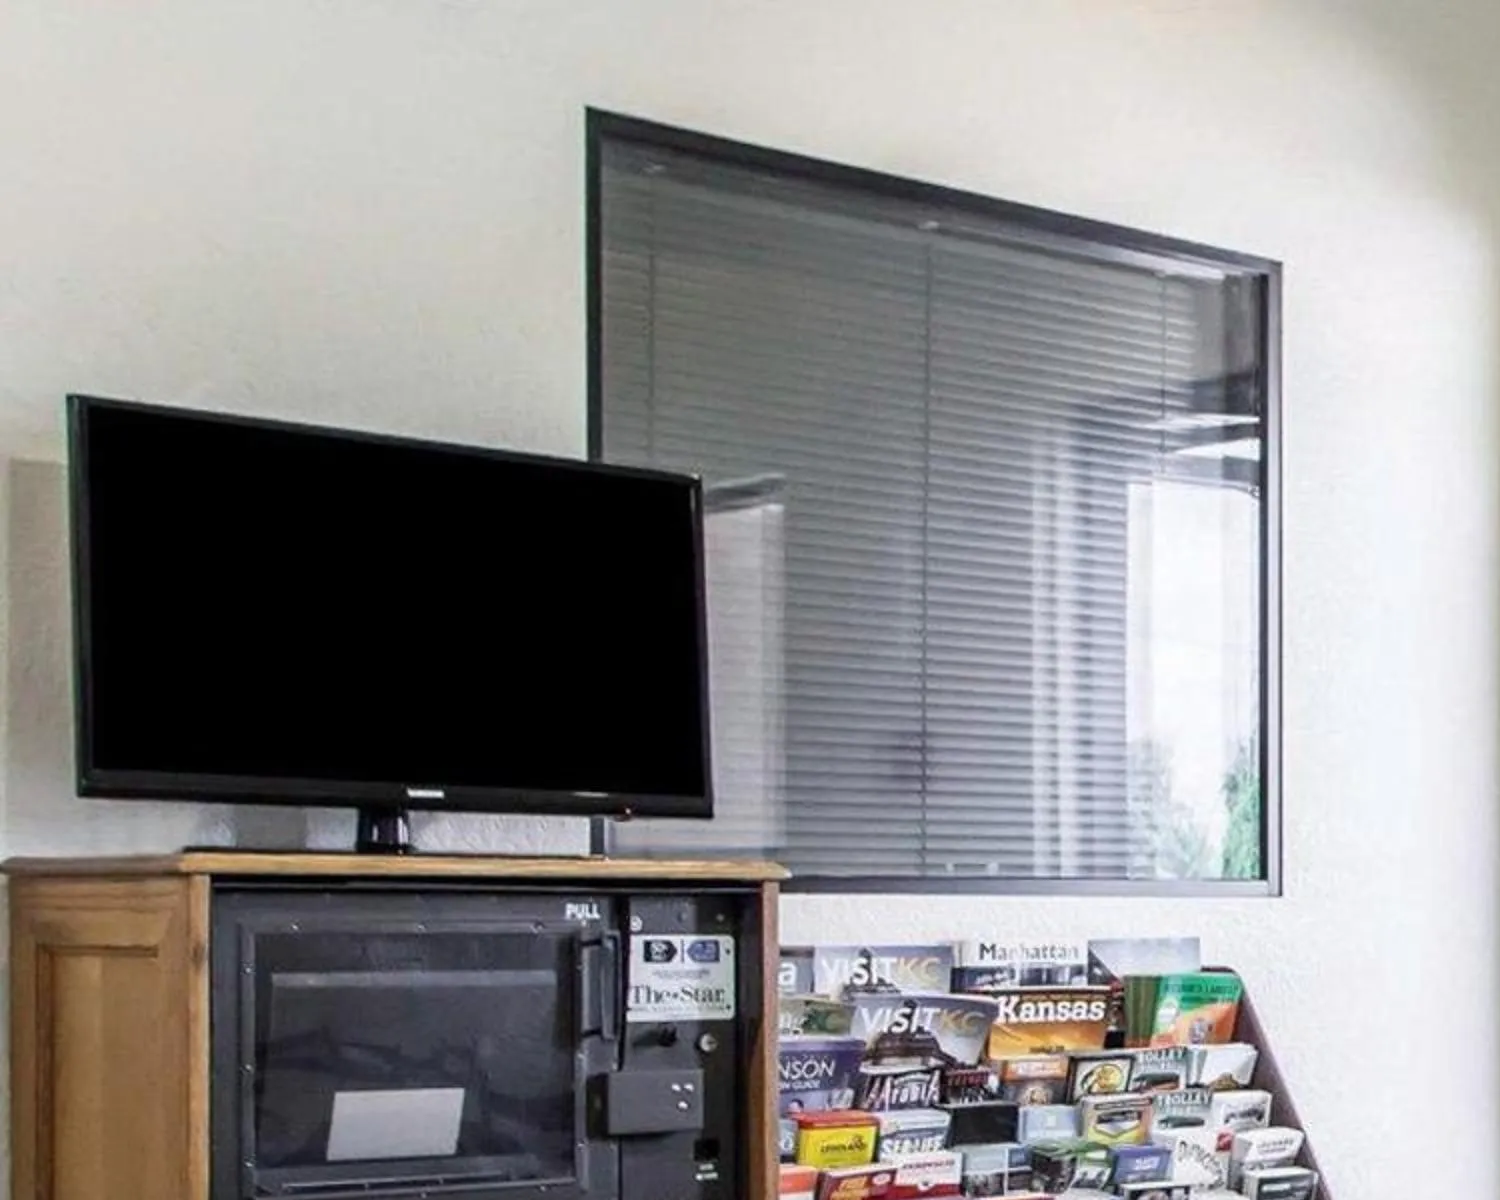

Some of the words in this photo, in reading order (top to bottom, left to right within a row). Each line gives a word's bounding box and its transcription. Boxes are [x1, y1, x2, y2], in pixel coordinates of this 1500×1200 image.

[565, 903, 601, 920] PULL
[979, 943, 1080, 961] Manhattan
[999, 995, 1107, 1024] Kansas
